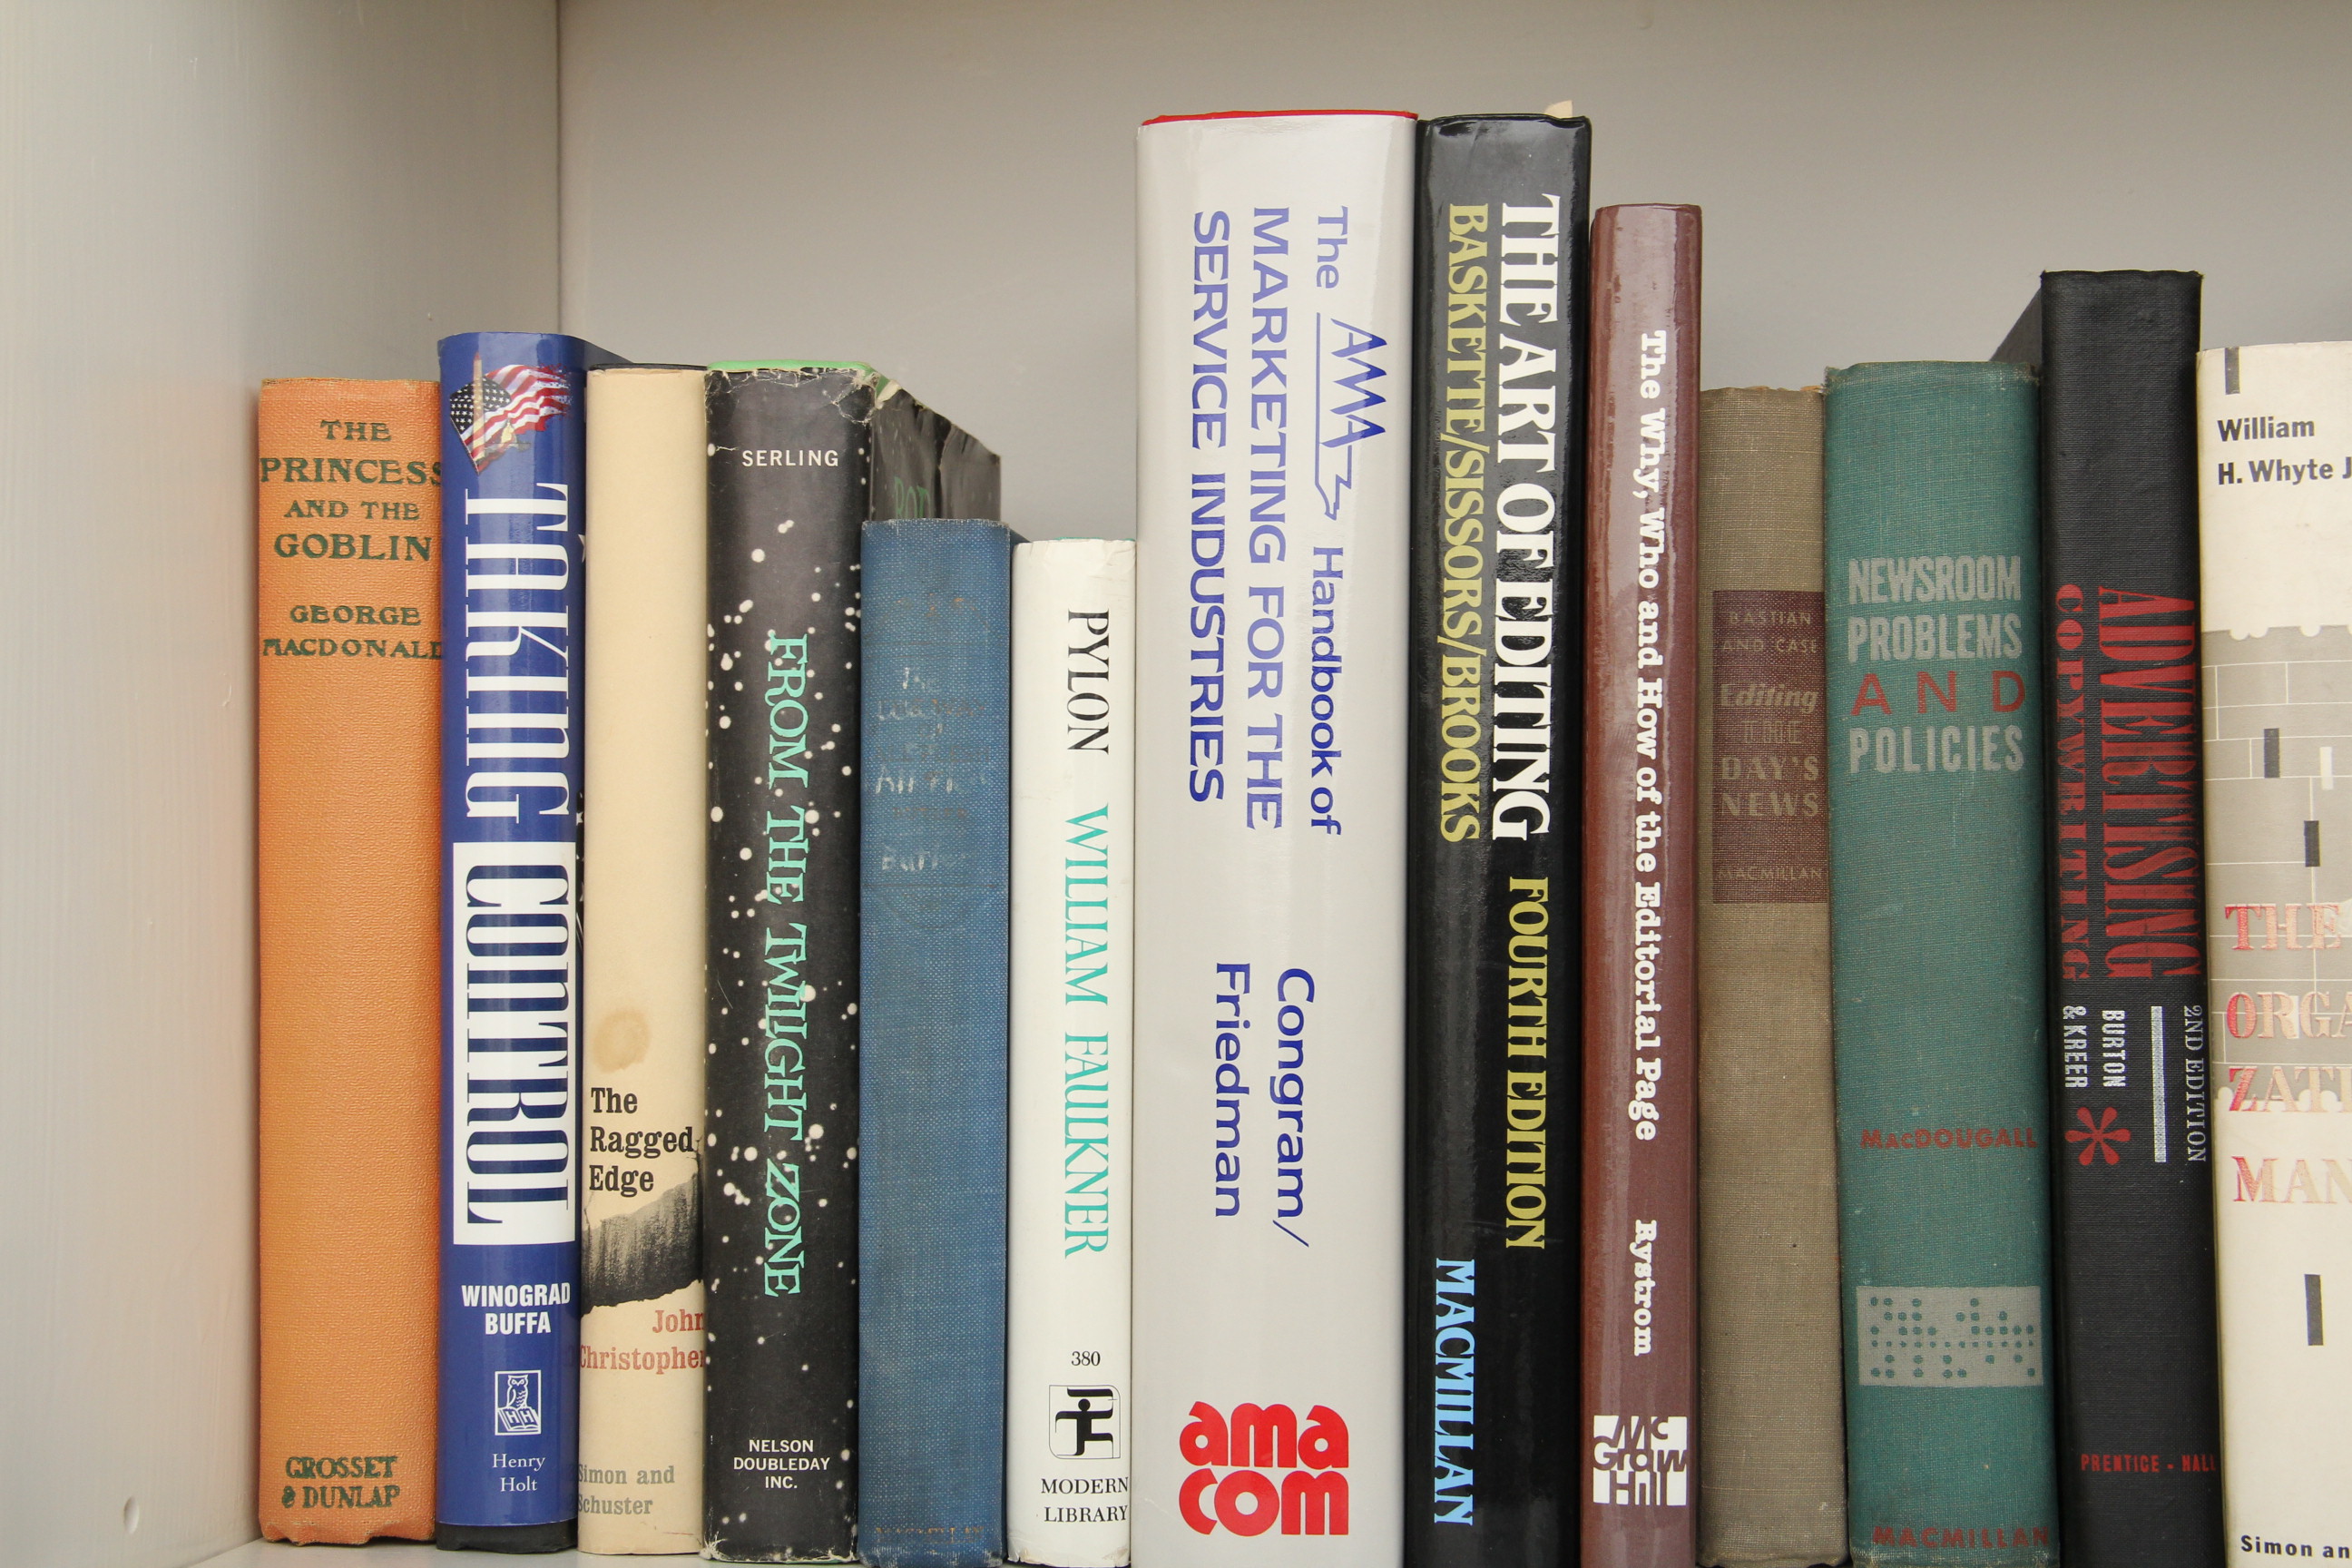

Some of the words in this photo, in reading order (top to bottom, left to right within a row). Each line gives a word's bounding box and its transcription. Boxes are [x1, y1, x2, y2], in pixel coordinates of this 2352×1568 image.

[1315, 205, 1348, 289] The
[1498, 192, 1562, 328] THE
[1191, 210, 1230, 450] SERVICE
[1248, 206, 1290, 564] MARKETING
[1640, 329, 1668, 400] The
[319, 419, 392, 442] THE
[1496, 333, 1557, 474] ART
[2217, 416, 2315, 442] William
[741, 449, 839, 467] SERLING
[1632, 407, 1667, 499] Why,
[2218, 462, 2243, 485] H.
[2248, 458, 2334, 485] Whyte
[283, 499, 349, 520] AND
[360, 500, 420, 522] THE
[1495, 482, 1556, 570] OF
[273, 533, 432, 562] GOBLIN
[1637, 506, 1666, 590] Who
[1847, 554, 2022, 605] NEWSROOM
[289, 604, 422, 626] GEORGE
[1189, 472, 1227, 802] INDUSTRIES
[1246, 585, 1285, 701] FOR
[1637, 601, 1664, 671] and
[1847, 612, 2023, 662] PROBLEMS
[465, 482, 571, 824] TAKING
[1065, 608, 1110, 755] PYLON
[1310, 546, 1344, 779] Handbook
[764, 632, 809, 790] FROM
[1492, 578, 1555, 842] EDITING
[1636, 677, 1663, 760] How
[1720, 682, 1819, 714] Editing
[1850, 670, 2026, 716] AND
[1740, 720, 1804, 744] THE
[1849, 725, 2024, 772] POLICIES
[1246, 712, 1284, 830] THE
[1636, 766, 1663, 803] of
[1720, 754, 1819, 782] DAY'S
[2055, 583, 2091, 981] COPYWRITING
[2098, 584, 2202, 980] ADVERTISING
[1310, 786, 1343, 836] of
[1720, 791, 1819, 818] NEWS
[766, 804, 809, 906] THE
[1635, 810, 1662, 874] the
[1063, 804, 1109, 1007] WILLIAM
[2224, 902, 2342, 951] THE
[1506, 877, 1549, 1059] FOURTH
[1634, 880, 1662, 1051] Editorial
[466, 863, 571, 1225] CONTROL
[764, 921, 809, 1142] TWILIGHT
[2063, 1025, 2089, 1088] KREER
[2102, 1009, 2127, 1087] BURTON
[2183, 1004, 2203, 1052] 2ND
[591, 1087, 639, 1114] The
[1215, 962, 1250, 1218] Friedman
[1628, 1056, 1661, 1142] Page
[2185, 1057, 2207, 1162] EDITION
[590, 1125, 695, 1160] Ragged
[1063, 1031, 1110, 1261] FAULKNER
[1504, 1069, 1547, 1250] EDITION
[589, 1164, 655, 1198] Edge
[764, 1158, 806, 1298] ZONE
[461, 1282, 572, 1308] WINOGRAD
[1629, 1219, 1658, 1358] Rystrom
[485, 1311, 552, 1336] BUFFA
[652, 1308, 705, 1334] John
[1070, 1350, 1102, 1367] 380
[1434, 1258, 1476, 1526] MACMILLAN
[492, 1453, 546, 1472] Henry
[732, 1456, 831, 1472] DOUBLEDAY
[748, 1438, 814, 1454] NELSON
[1179, 1400, 1349, 1470] ama
[285, 1455, 398, 1479] GROSSET
[301, 1484, 402, 1509] DUNLAP
[500, 1475, 538, 1492] Holt
[636, 1465, 676, 1485] and
[764, 1475, 799, 1490] INC.
[1040, 1476, 1129, 1494] MODERN
[1044, 1504, 1129, 1524] LIBRARY
[1179, 1467, 1349, 1537] com
[1871, 1524, 2049, 1550] MACMILLAN
[2240, 1534, 2313, 1557] Simon
